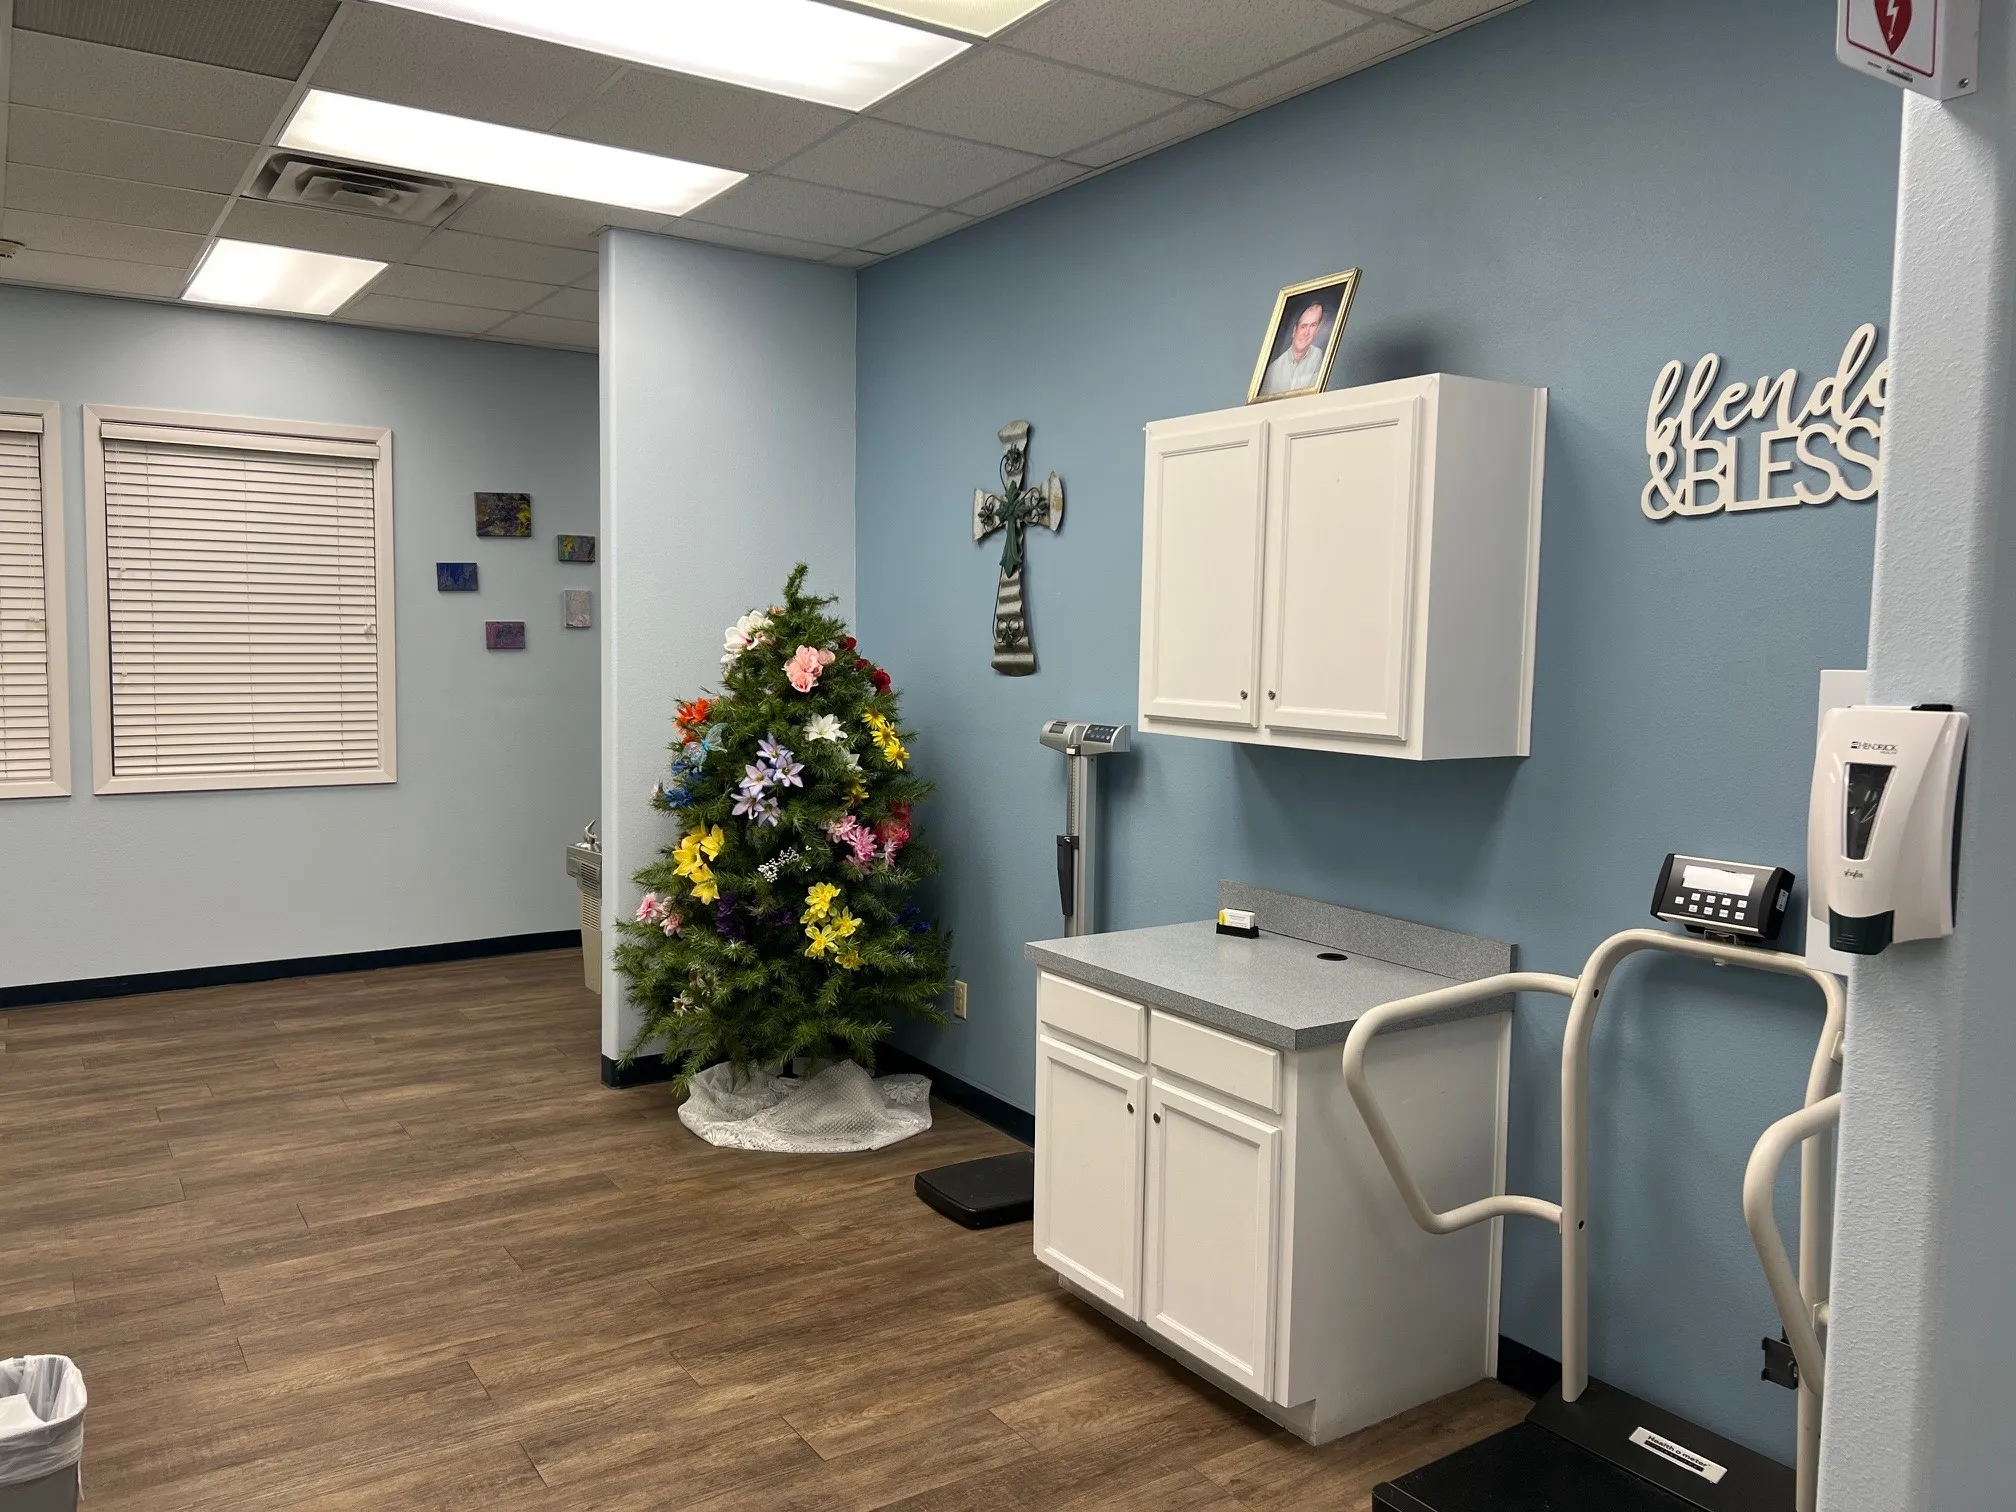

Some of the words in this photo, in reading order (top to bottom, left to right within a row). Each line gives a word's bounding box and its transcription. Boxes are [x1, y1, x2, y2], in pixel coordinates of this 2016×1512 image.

[1859, 742, 1897, 751] HENDRICK
[1648, 1436, 1674, 1451] Health
[1683, 1453, 1707, 1466] meter
